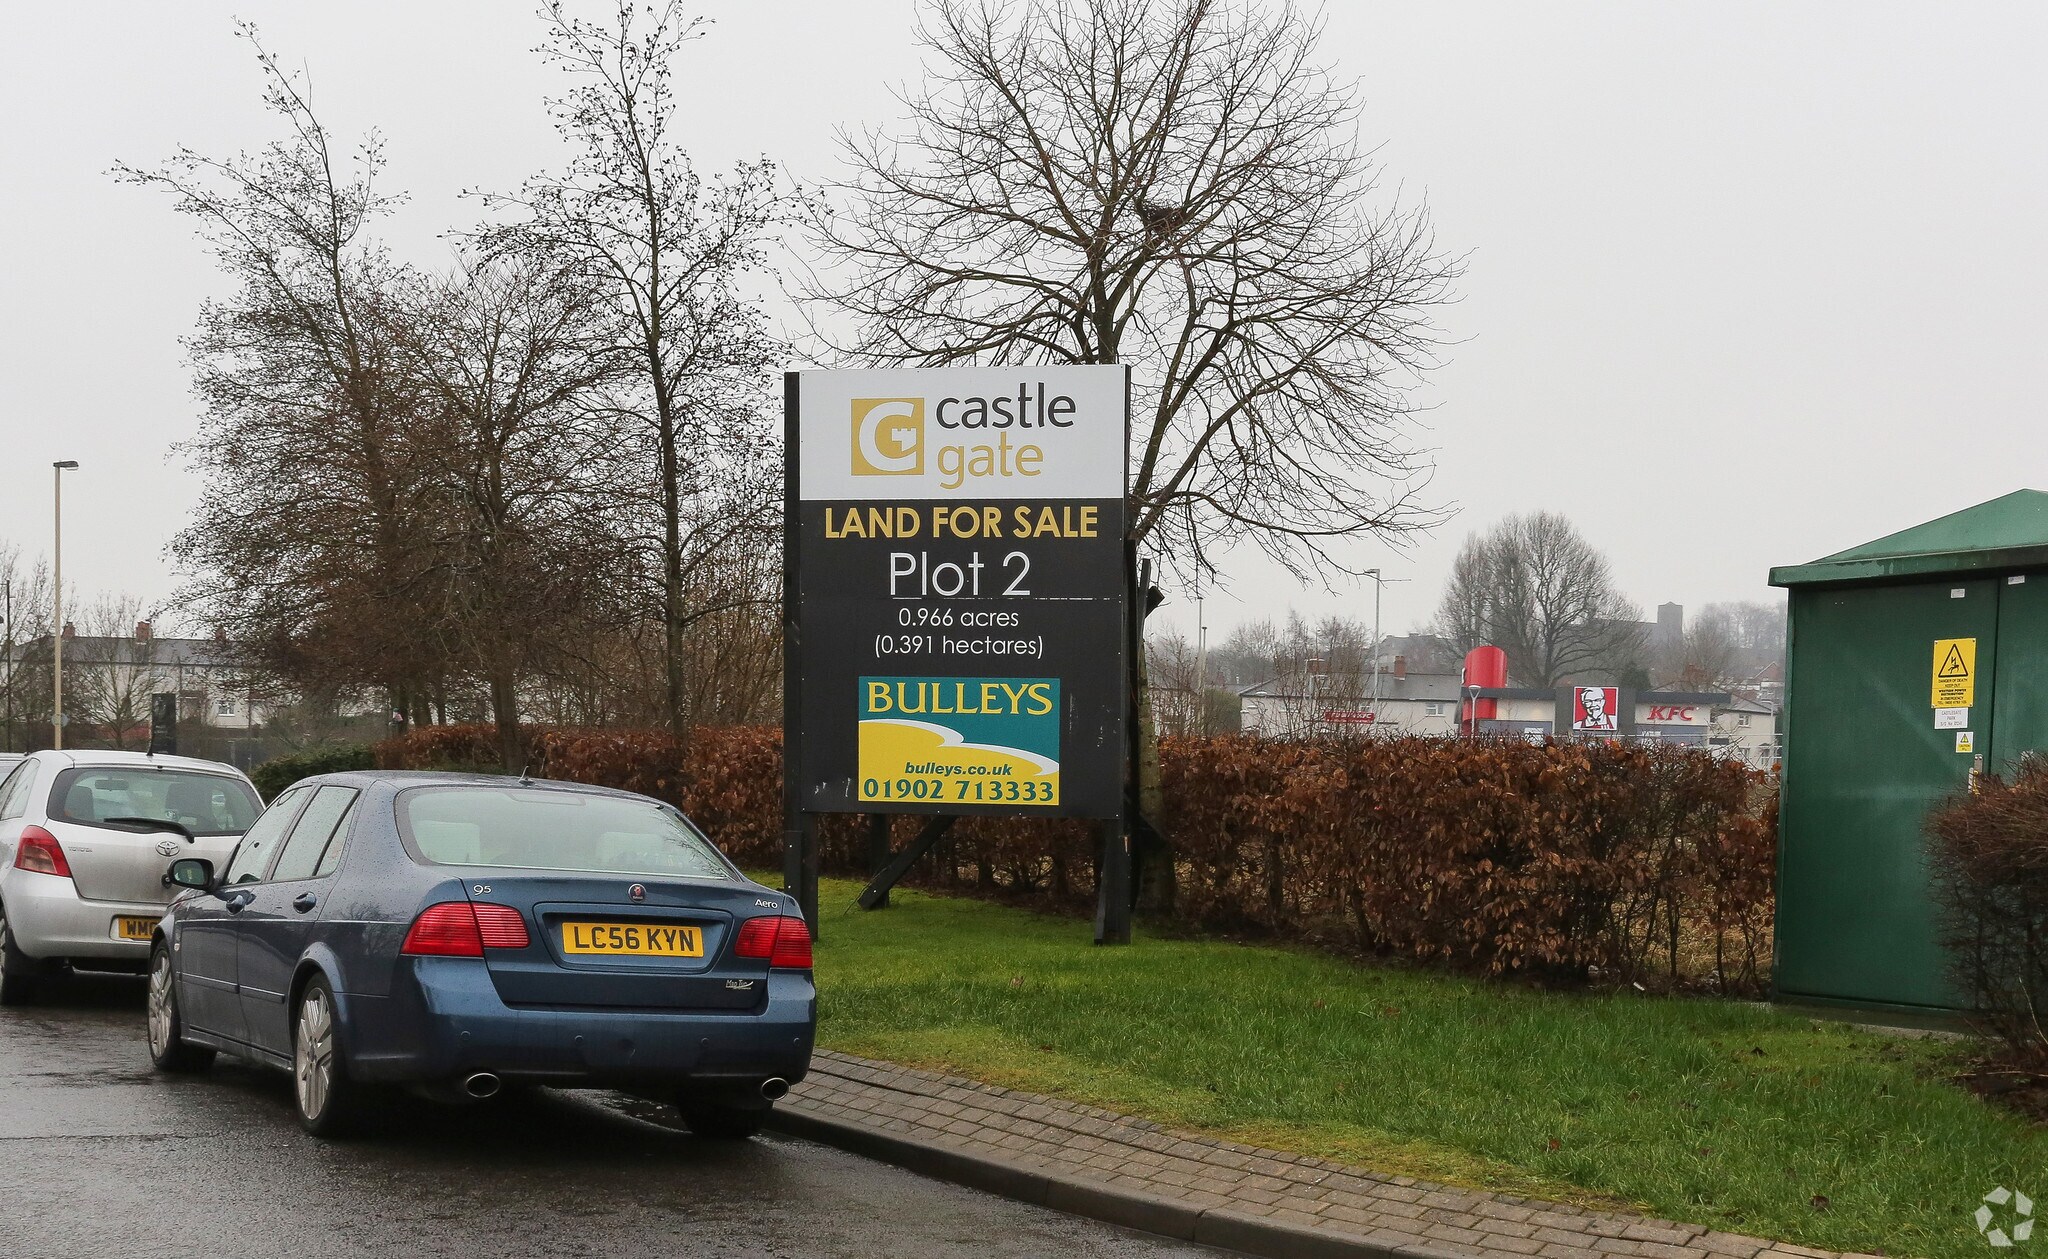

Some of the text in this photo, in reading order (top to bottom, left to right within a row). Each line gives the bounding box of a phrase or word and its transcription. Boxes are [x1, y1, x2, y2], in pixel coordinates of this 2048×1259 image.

[935, 381, 1077, 429] castle
[937, 432, 1044, 490] gate
[825, 506, 1098, 539] LAND FOR SALE
[890, 551, 1031, 597] Plot 2
[898, 608, 1019, 627] 0.966 acres
[874, 635, 1044, 659] (0.391 hectares)
[867, 682, 1053, 716] BULLEYS
[1647, 705, 1695, 721] KFC
[905, 762, 1012, 777] bulleys.co.uk
[863, 779, 1054, 802] 01902 713333
[755, 899, 778, 909] Aero
[573, 926, 695, 952] LC56 KYN
